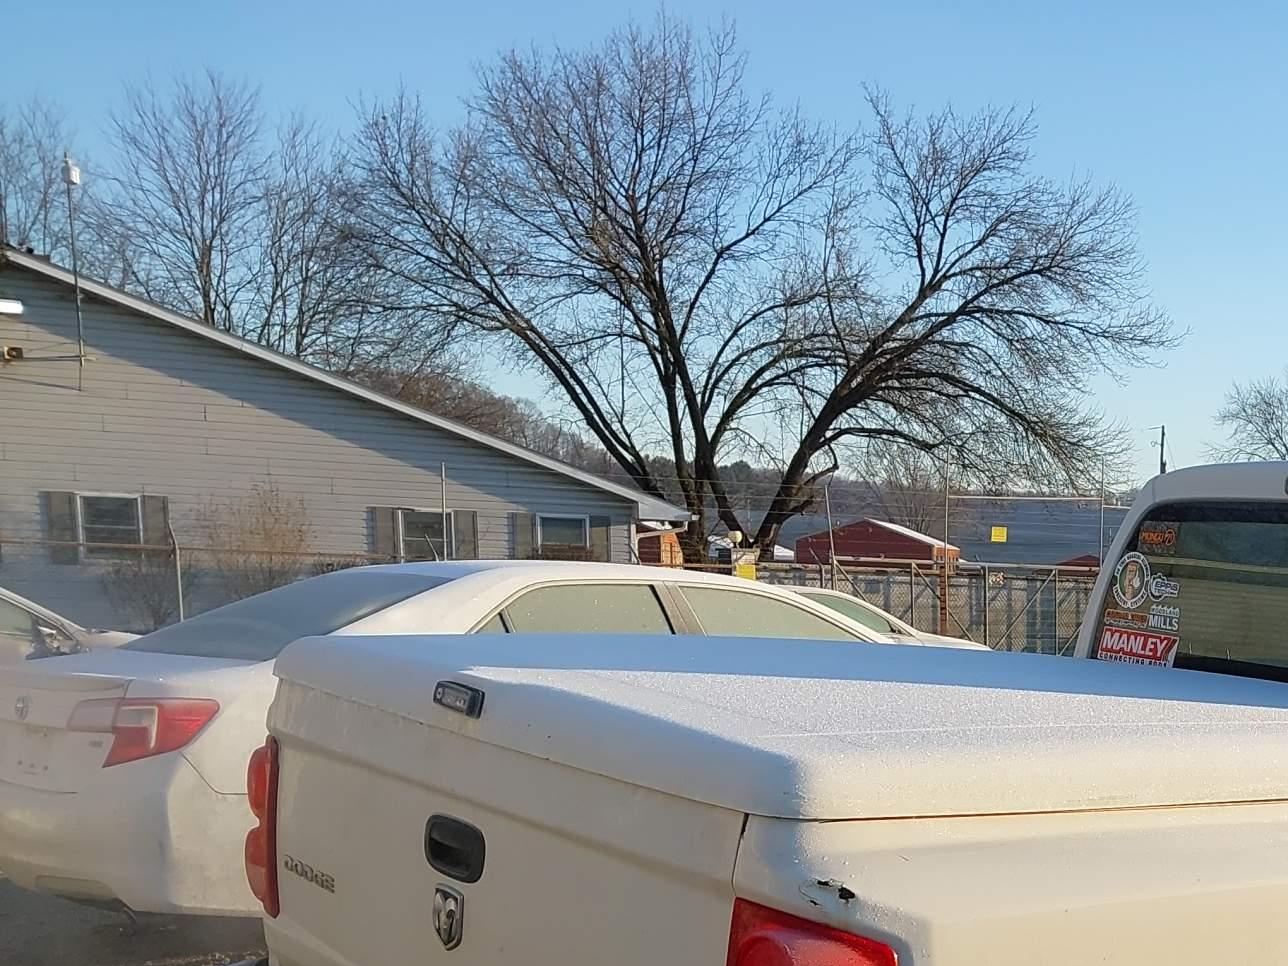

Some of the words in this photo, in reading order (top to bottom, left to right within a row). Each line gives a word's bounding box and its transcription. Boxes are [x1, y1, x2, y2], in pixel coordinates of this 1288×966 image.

[1149, 614, 1178, 631] MILLS
[1102, 630, 1168, 657] MANLEY
[1099, 652, 1145, 666] CONNECTING
[283, 853, 336, 894] DODGE
